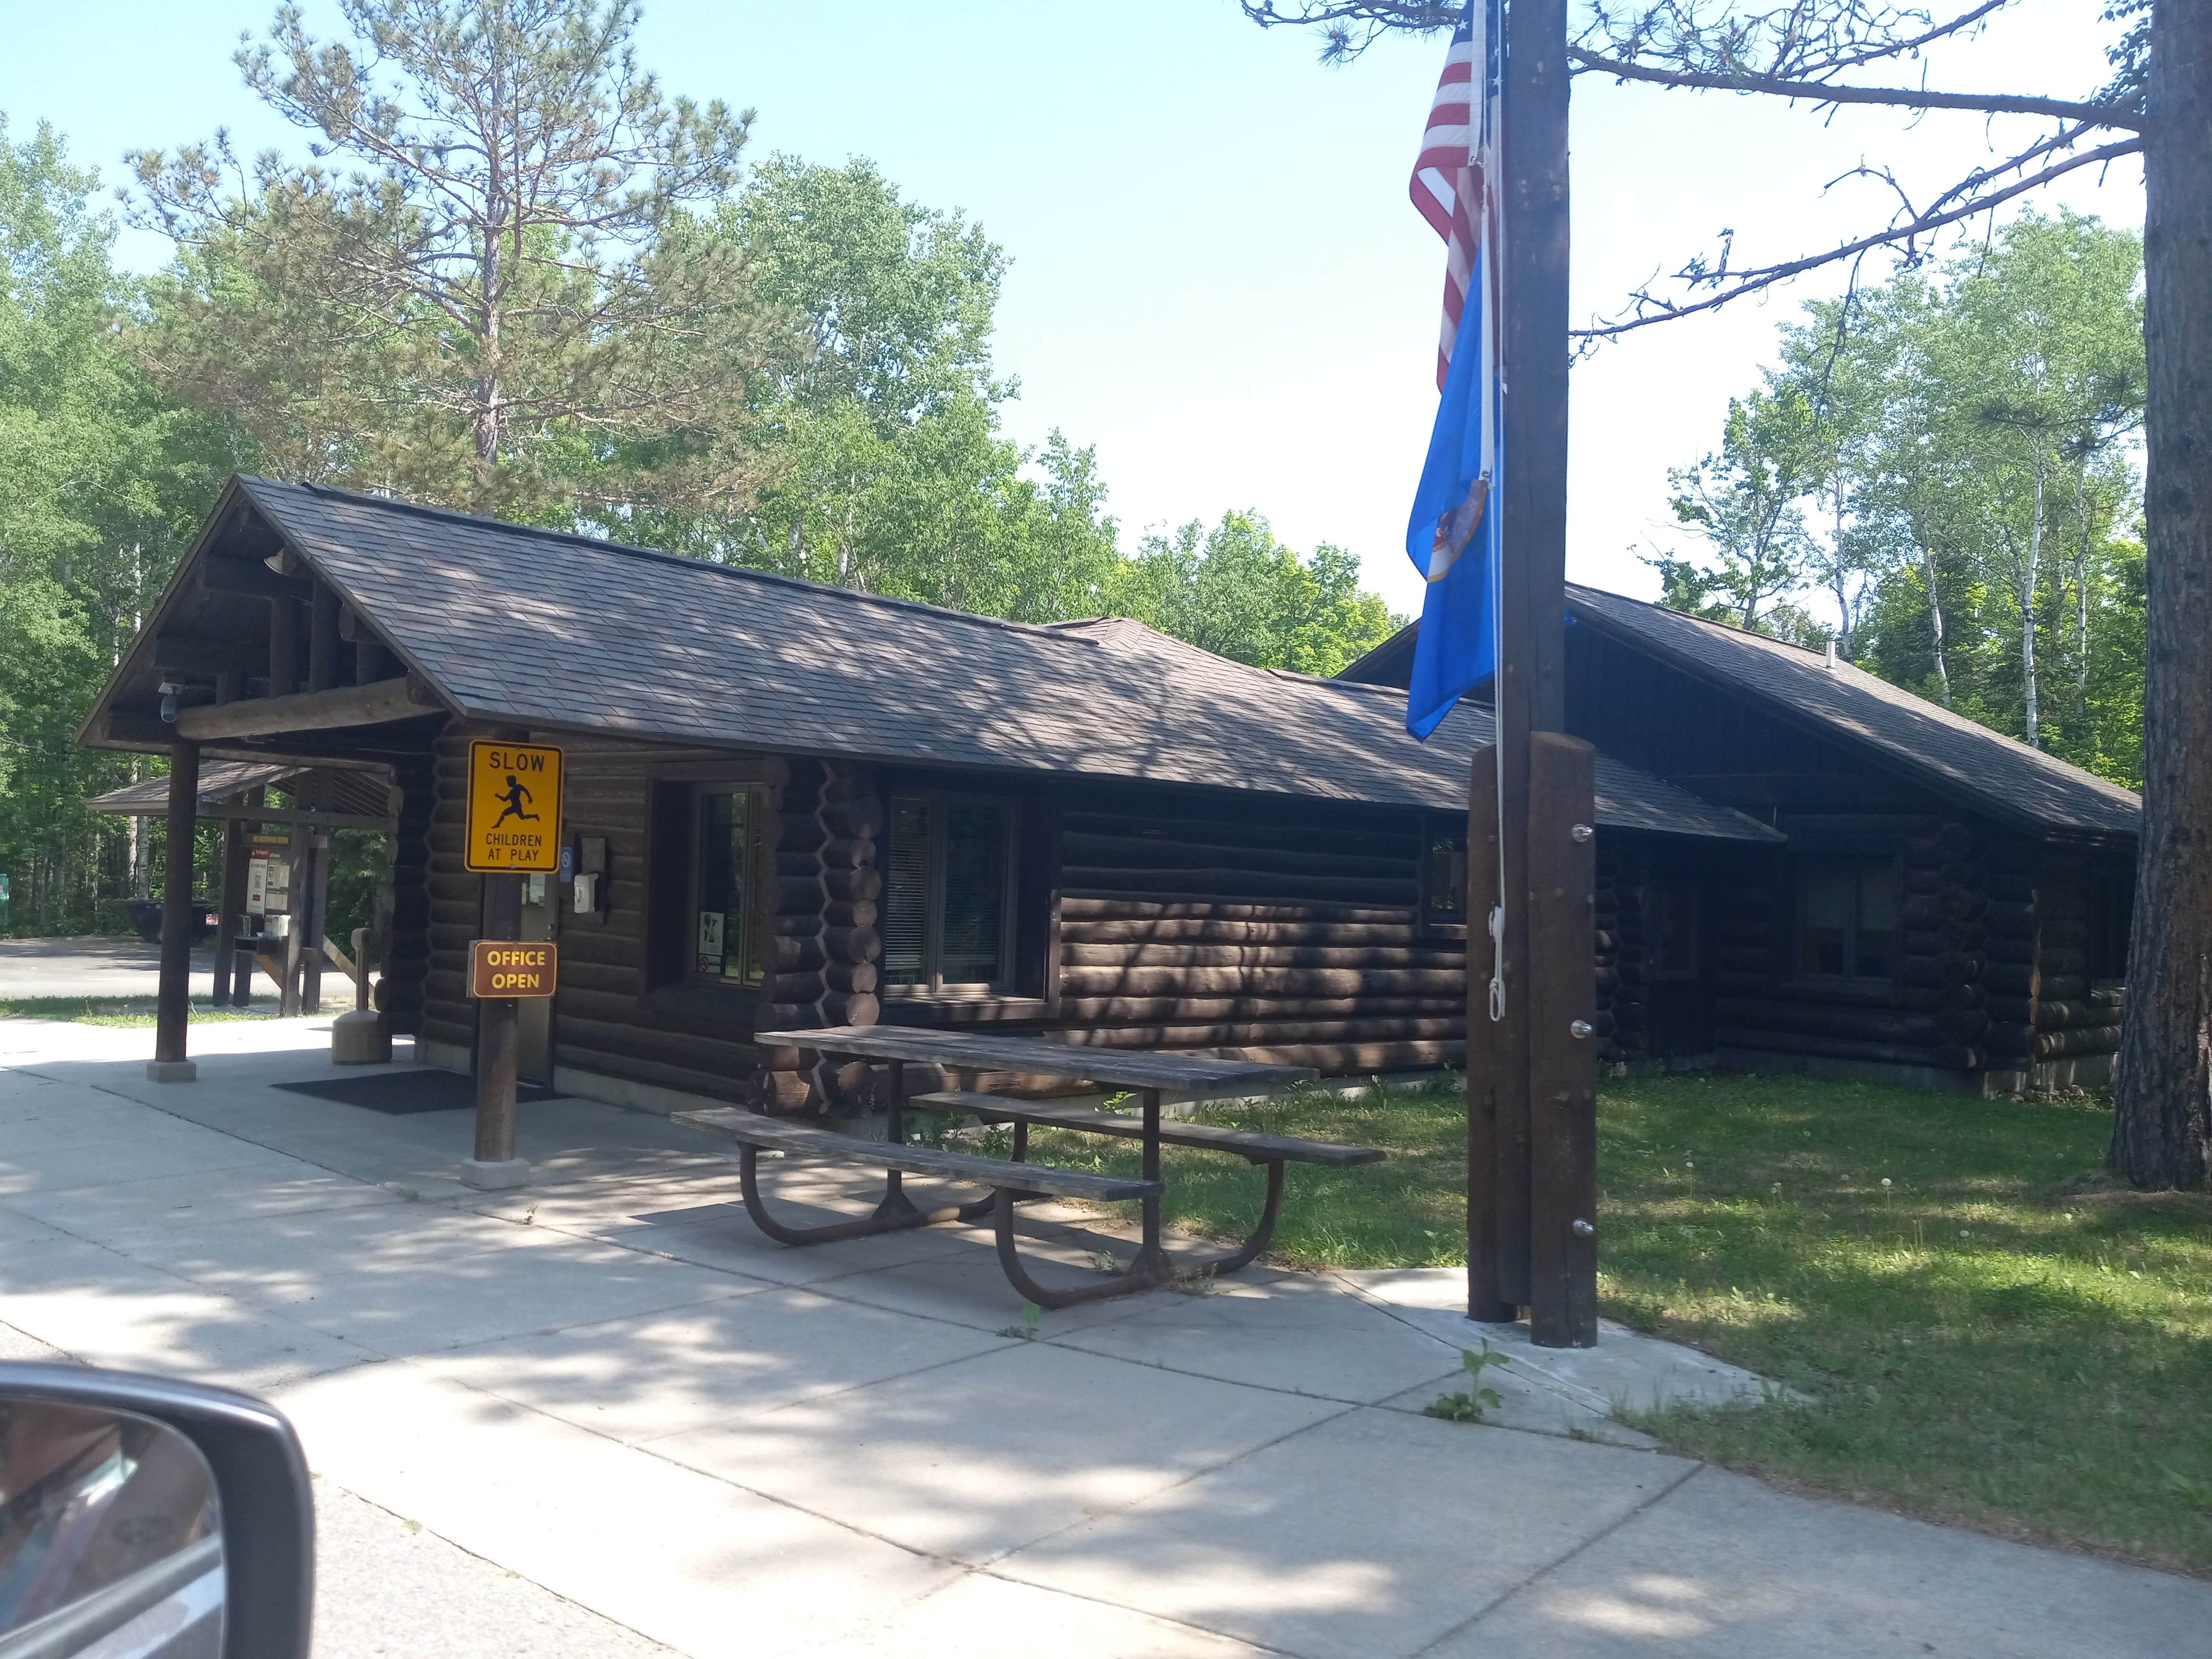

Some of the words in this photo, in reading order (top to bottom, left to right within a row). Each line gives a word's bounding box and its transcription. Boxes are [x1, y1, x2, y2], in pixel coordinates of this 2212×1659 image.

[489, 751, 544, 772] SLOW
[486, 833, 541, 846] CHILDREN
[488, 848, 501, 860] AT
[511, 849, 539, 861] PLAY
[487, 950, 545, 966] OFFICE
[492, 973, 540, 989] OPEN
